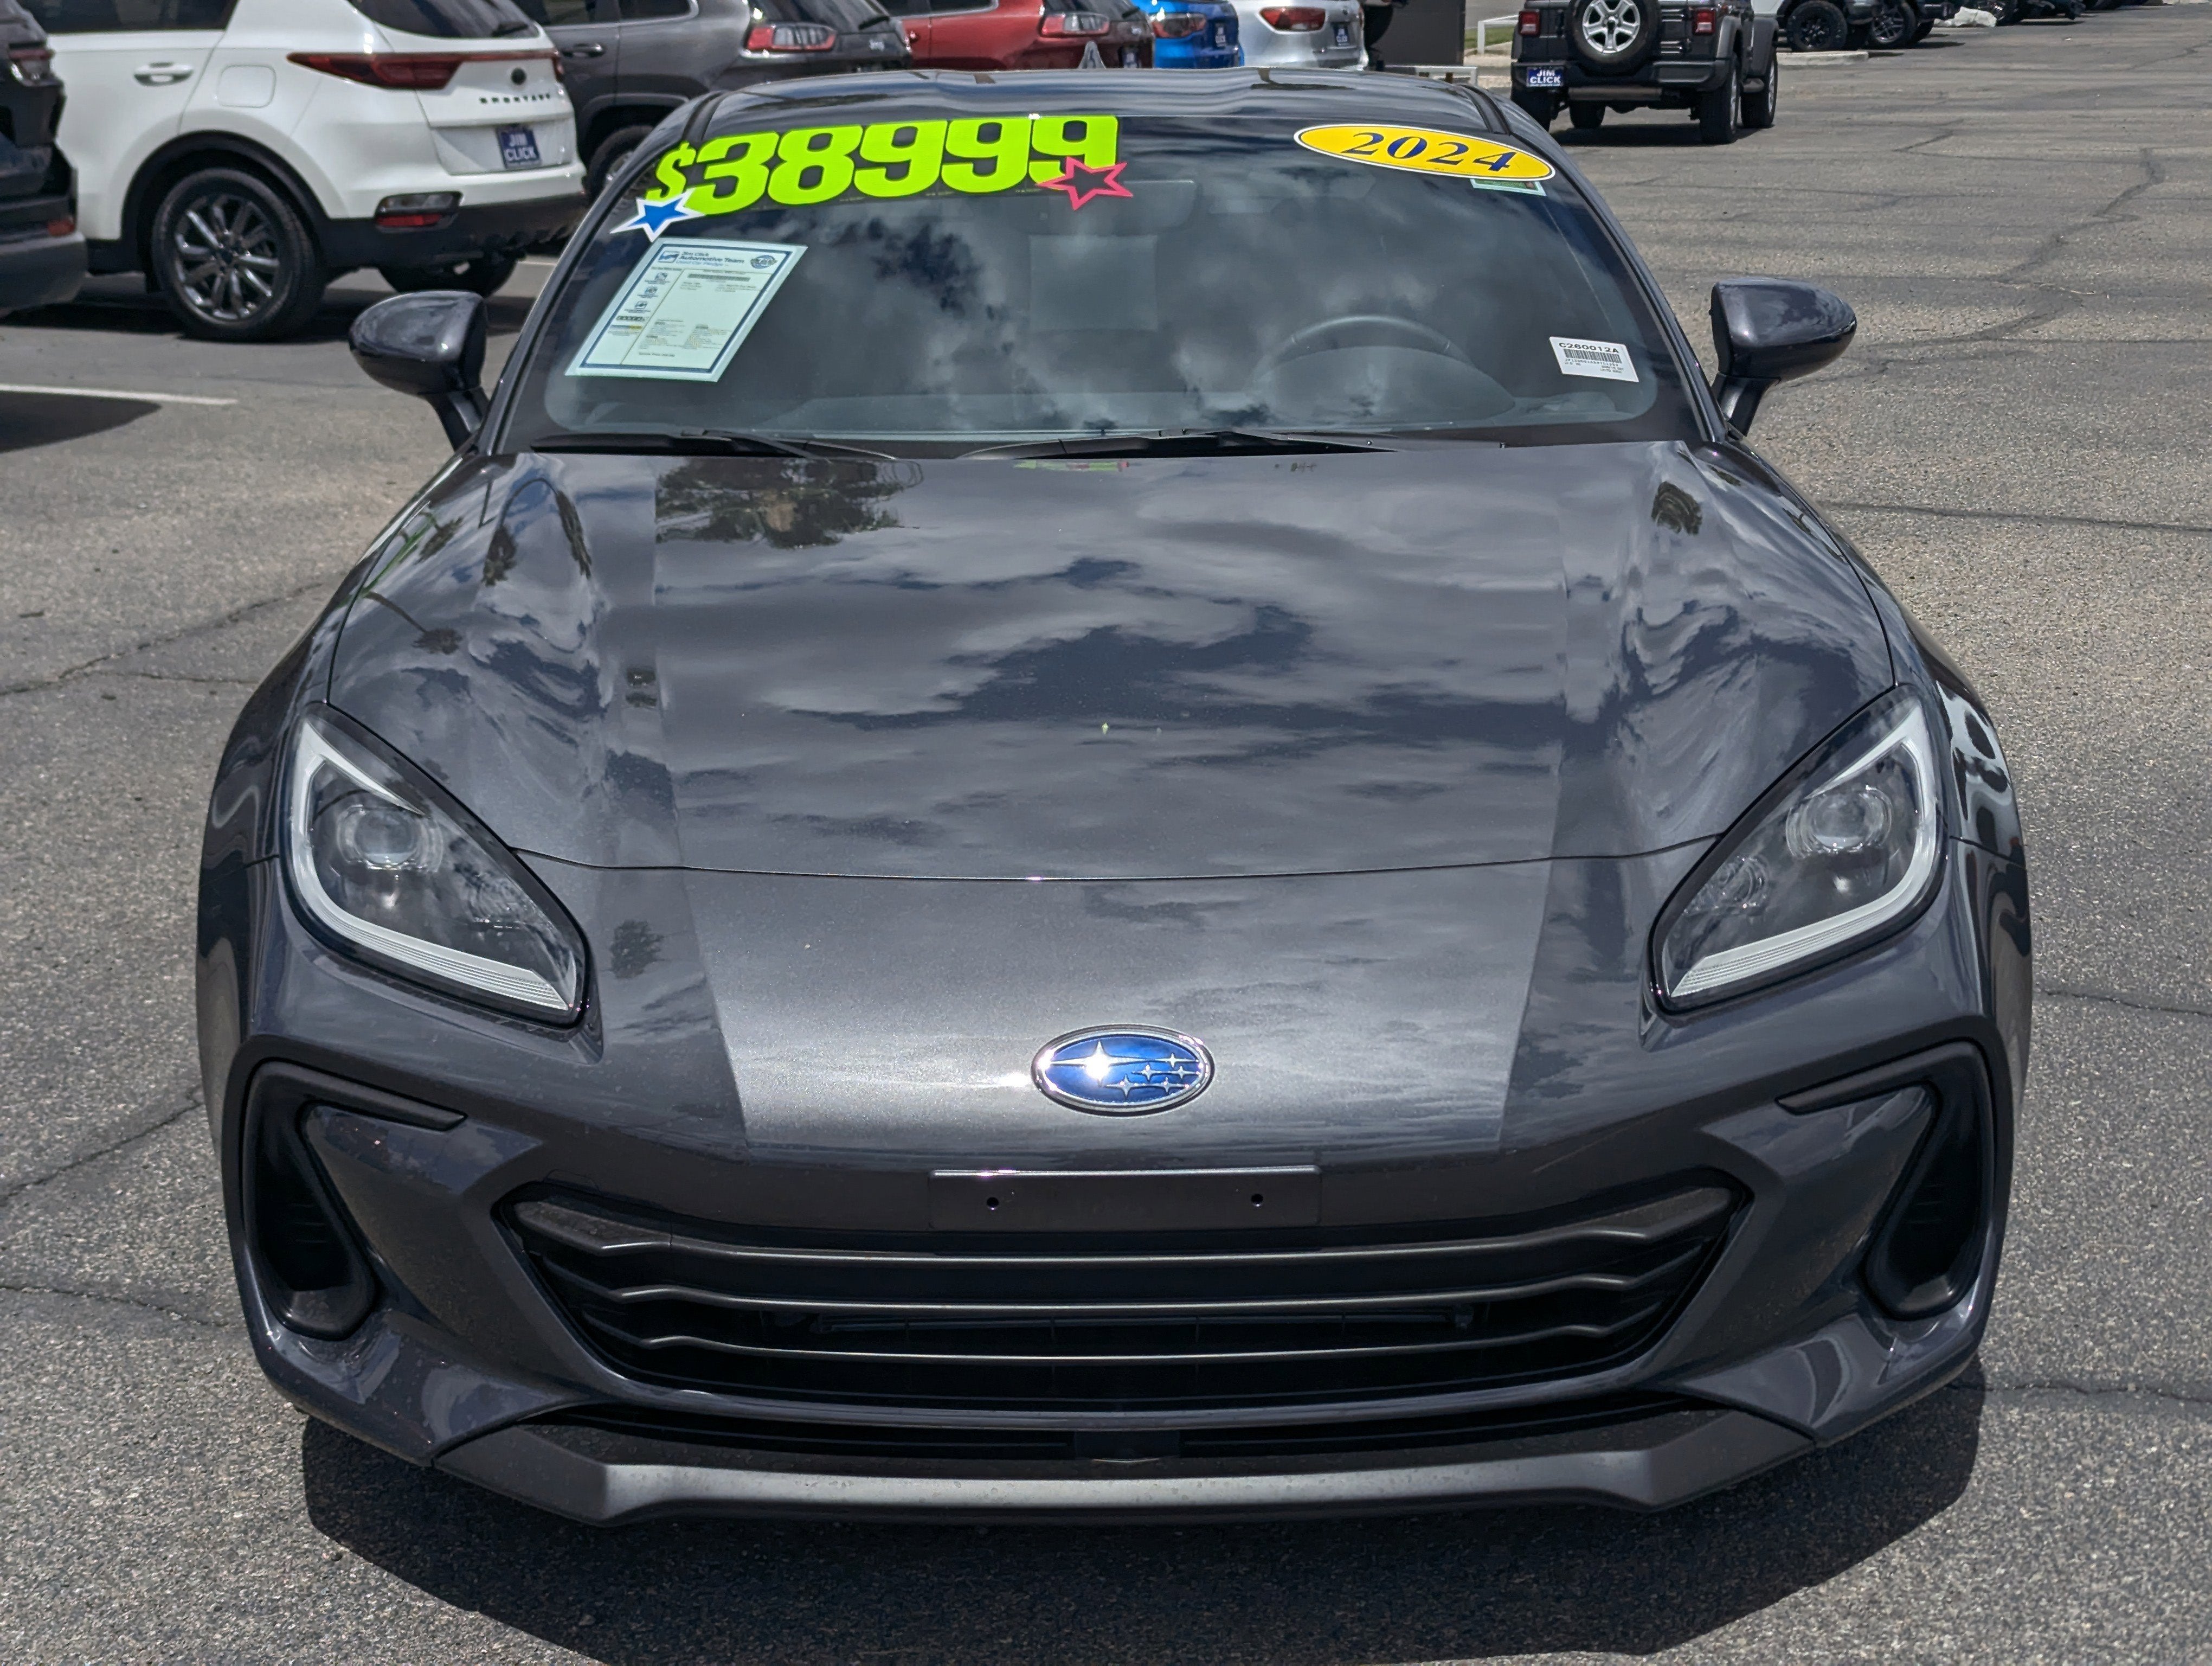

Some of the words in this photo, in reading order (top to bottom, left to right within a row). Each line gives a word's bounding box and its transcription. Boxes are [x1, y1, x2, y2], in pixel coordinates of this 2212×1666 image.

[504, 146, 537, 161] CLICK
[647, 116, 1118, 215] $38999
[1340, 132, 1517, 172] 2024
